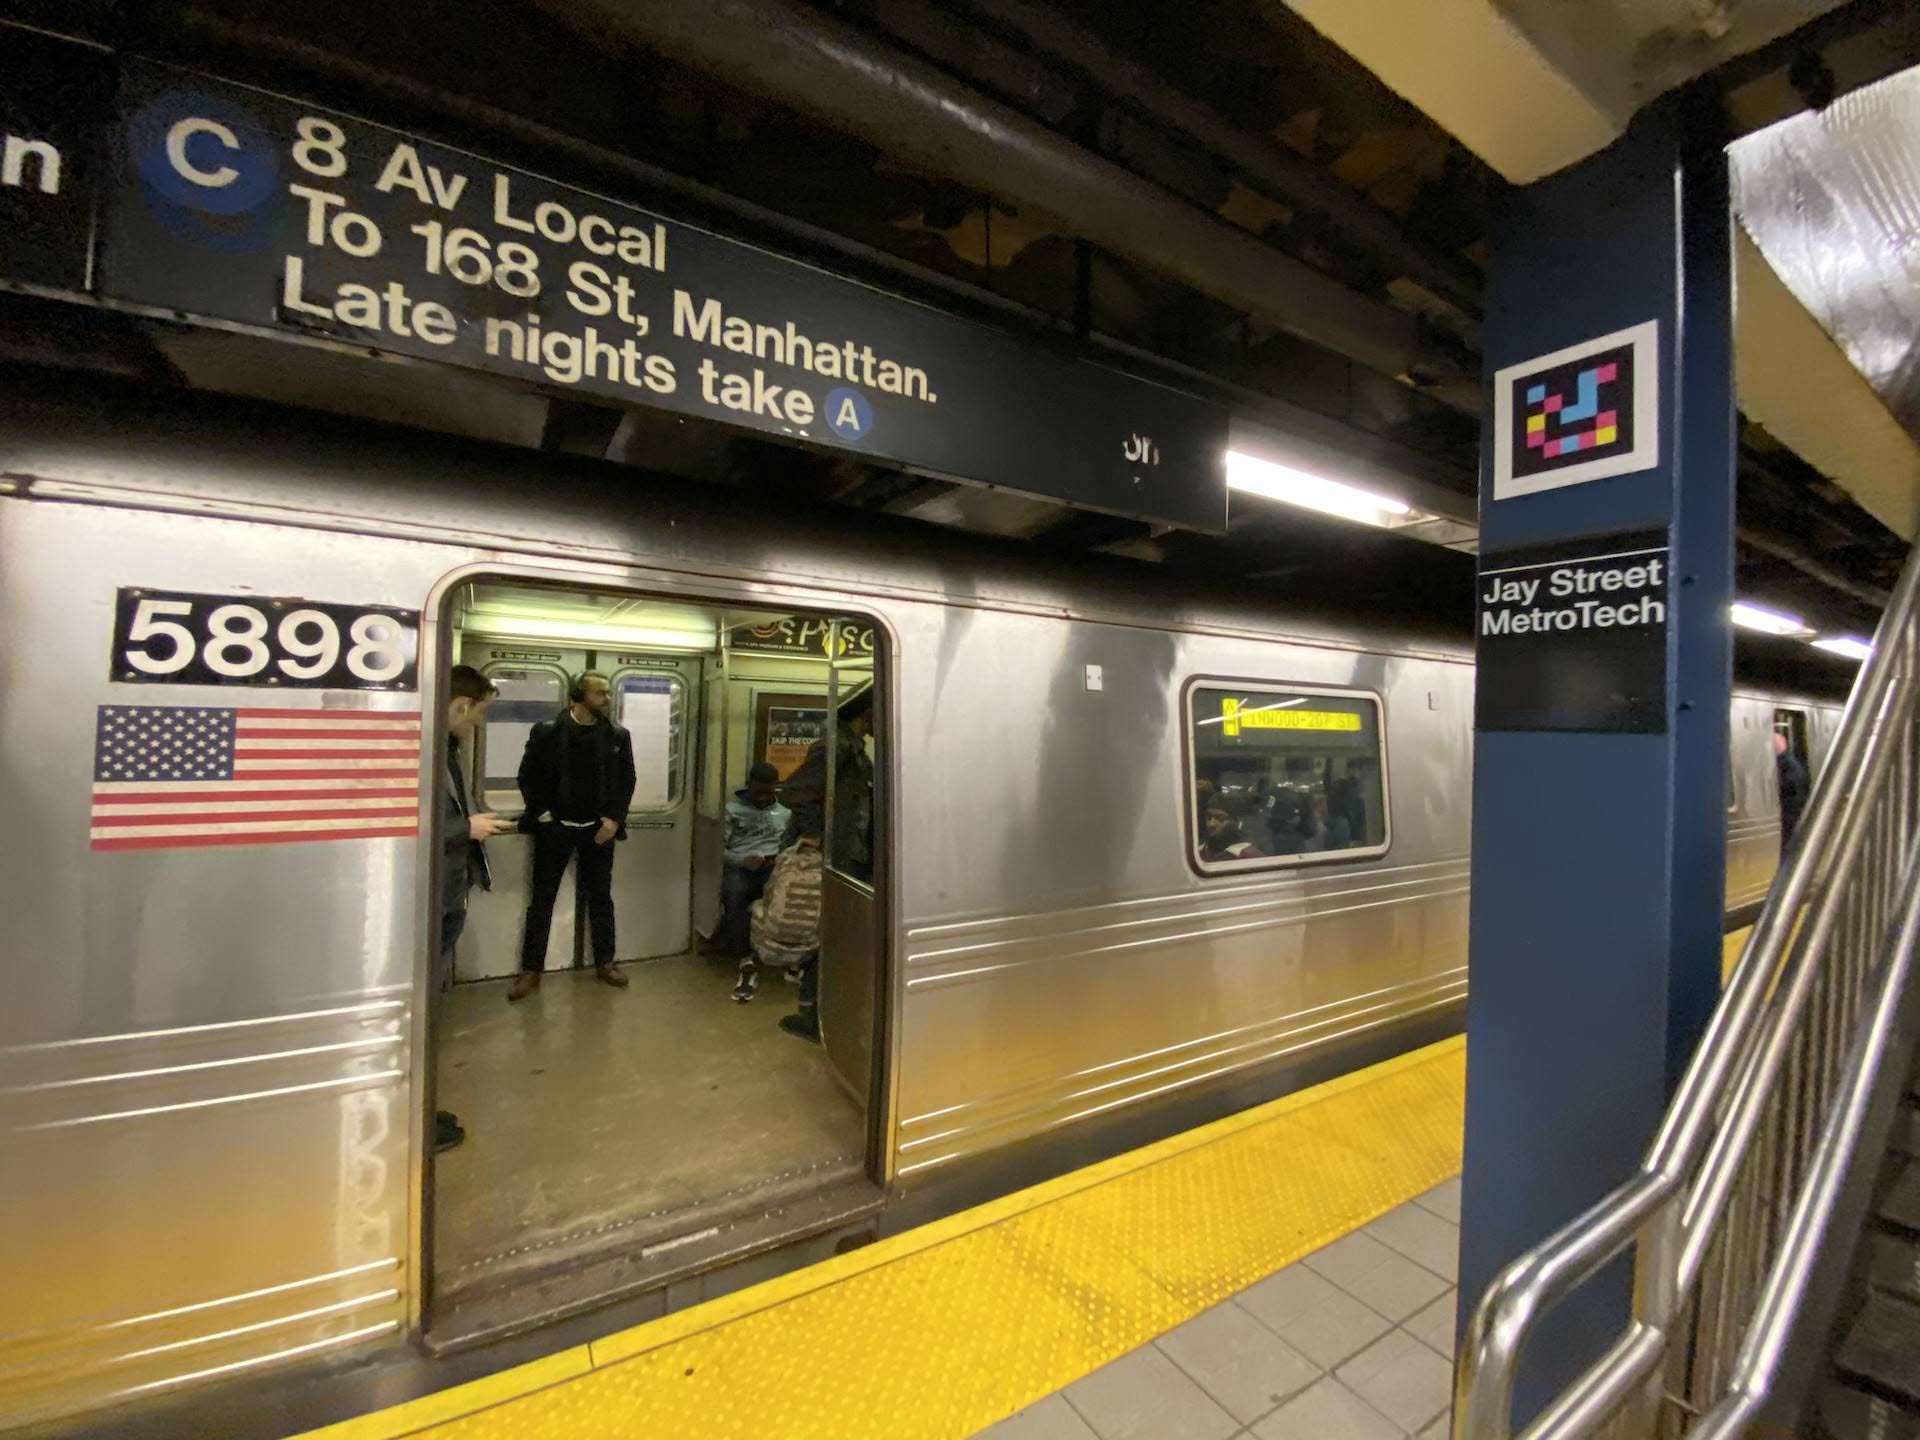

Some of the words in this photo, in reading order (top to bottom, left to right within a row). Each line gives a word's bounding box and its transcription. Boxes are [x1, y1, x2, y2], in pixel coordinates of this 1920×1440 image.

[166, 117, 240, 188] C
[291, 116, 348, 178] 8
[375, 143, 468, 211] Av
[493, 173, 666, 272] Local
[289, 183, 382, 258] To
[410, 220, 541, 298] 168
[565, 261, 649, 337] St,
[672, 289, 938, 404] Manhattan.
[283, 254, 457, 345] Late
[485, 313, 677, 394] nights
[698, 358, 815, 426] take
[835, 398, 861, 431] A
[1481, 595, 1665, 636] MetroTech
[1482, 577, 1541, 607] Jay
[1549, 558, 1663, 597] Street
[125, 599, 406, 682] 5898
